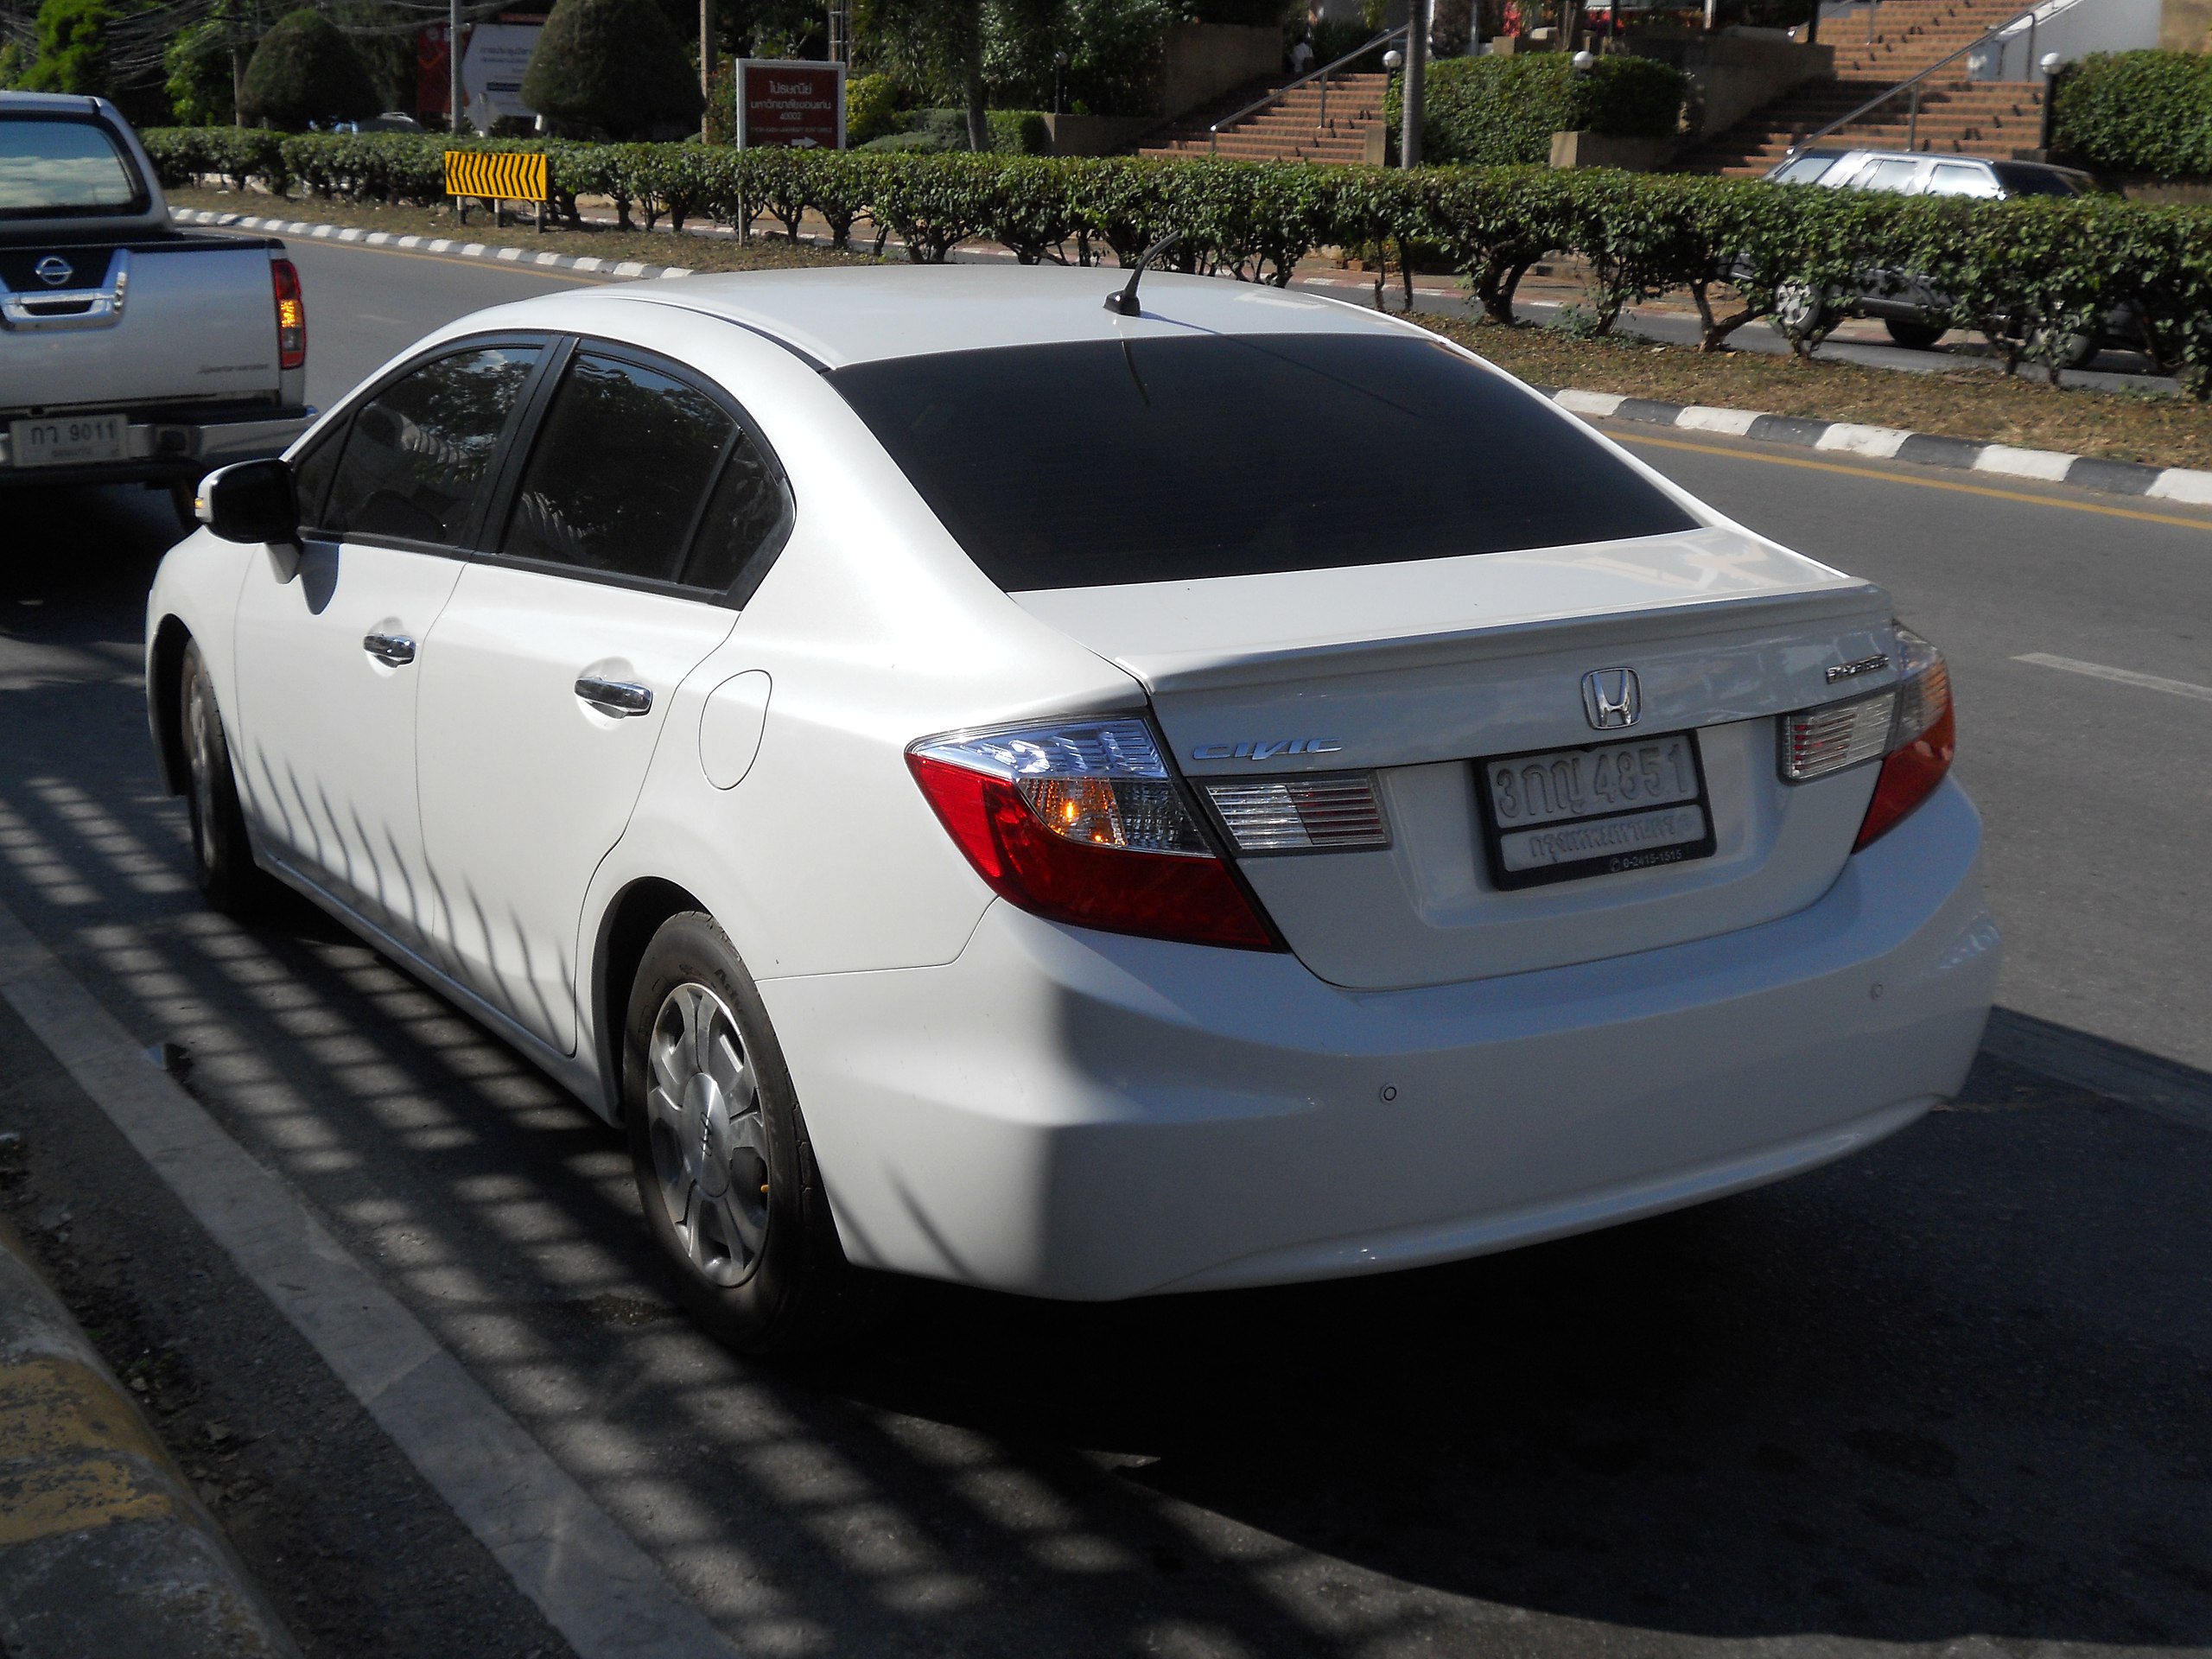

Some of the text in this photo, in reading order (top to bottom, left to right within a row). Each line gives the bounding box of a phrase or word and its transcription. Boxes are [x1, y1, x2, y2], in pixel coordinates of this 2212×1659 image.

[70, 419, 116, 442] 9011
[1193, 738, 1343, 760] CIVIC
[1593, 743, 1687, 804] 4851
